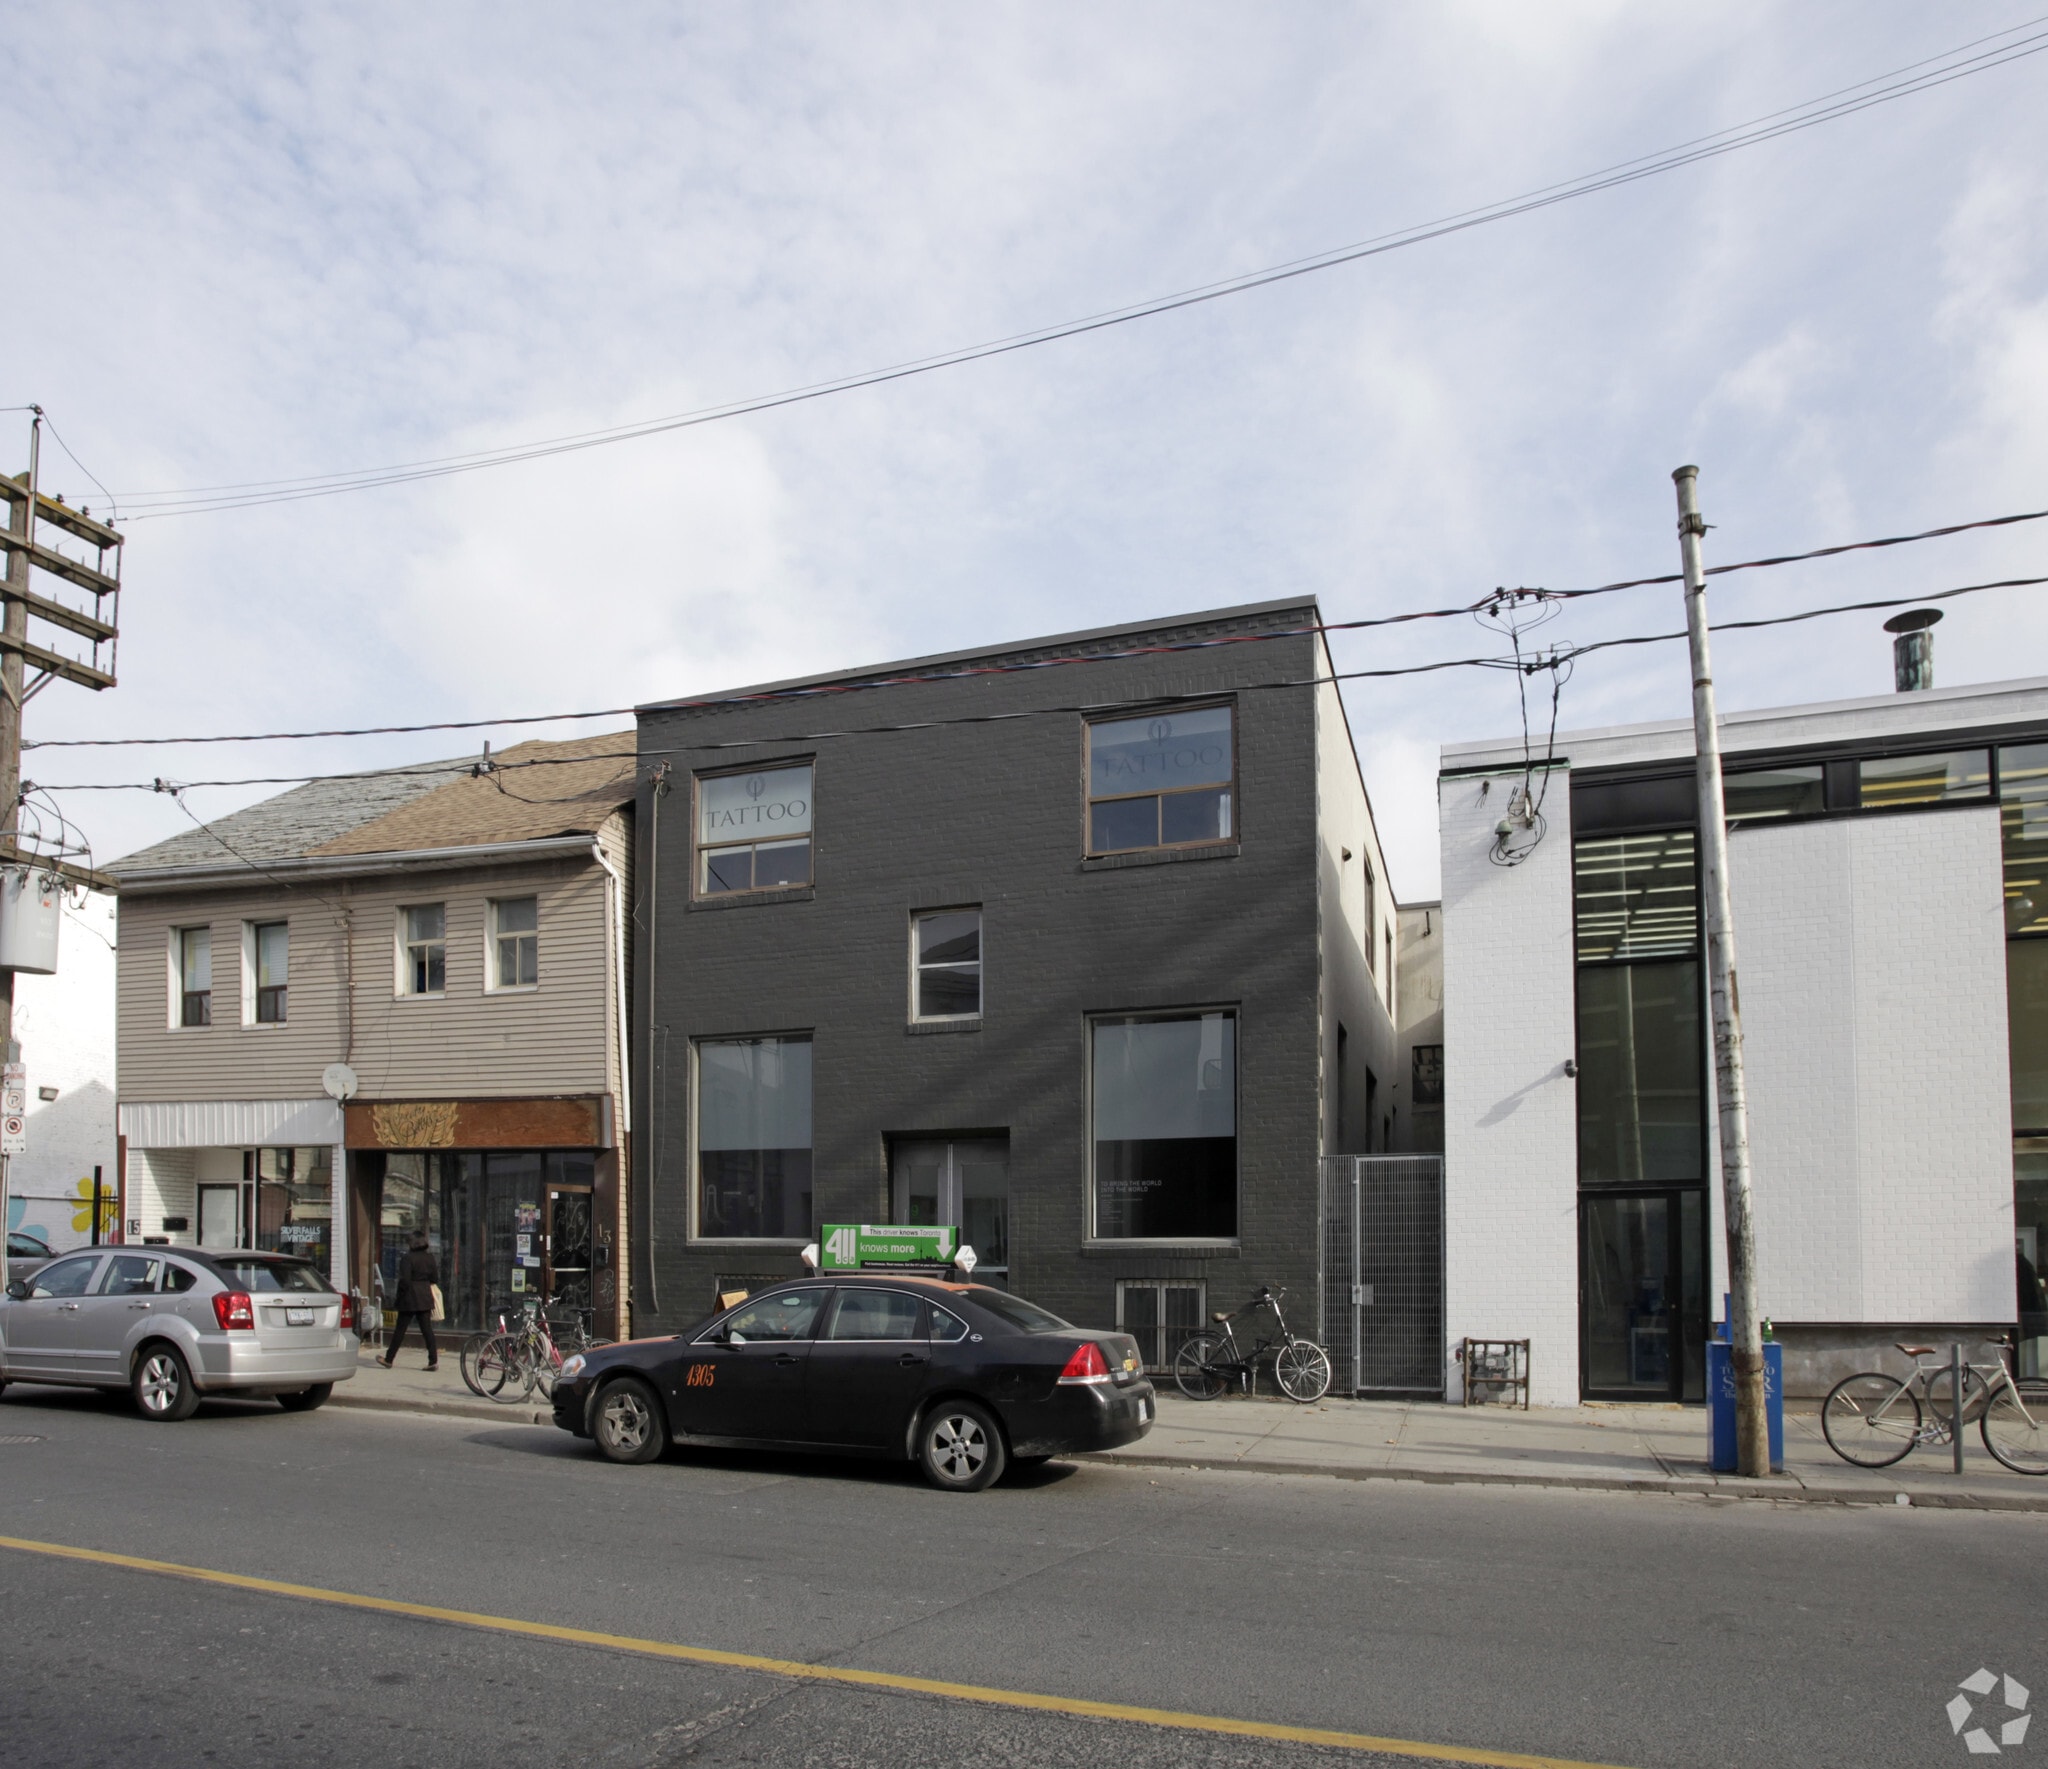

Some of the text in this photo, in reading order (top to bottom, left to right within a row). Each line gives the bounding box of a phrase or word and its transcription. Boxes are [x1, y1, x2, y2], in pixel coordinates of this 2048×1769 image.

[1102, 745, 1223, 777] TATTOO
[706, 800, 806, 828] TATTOO
[128, 1220, 140, 1234] 15
[281, 1226, 320, 1235] SILVER FALLS
[598, 1223, 612, 1243] 13
[287, 1234, 314, 1243] VINTAGE
[860, 1242, 915, 1254] knows more
[687, 1364, 716, 1386] 1305
